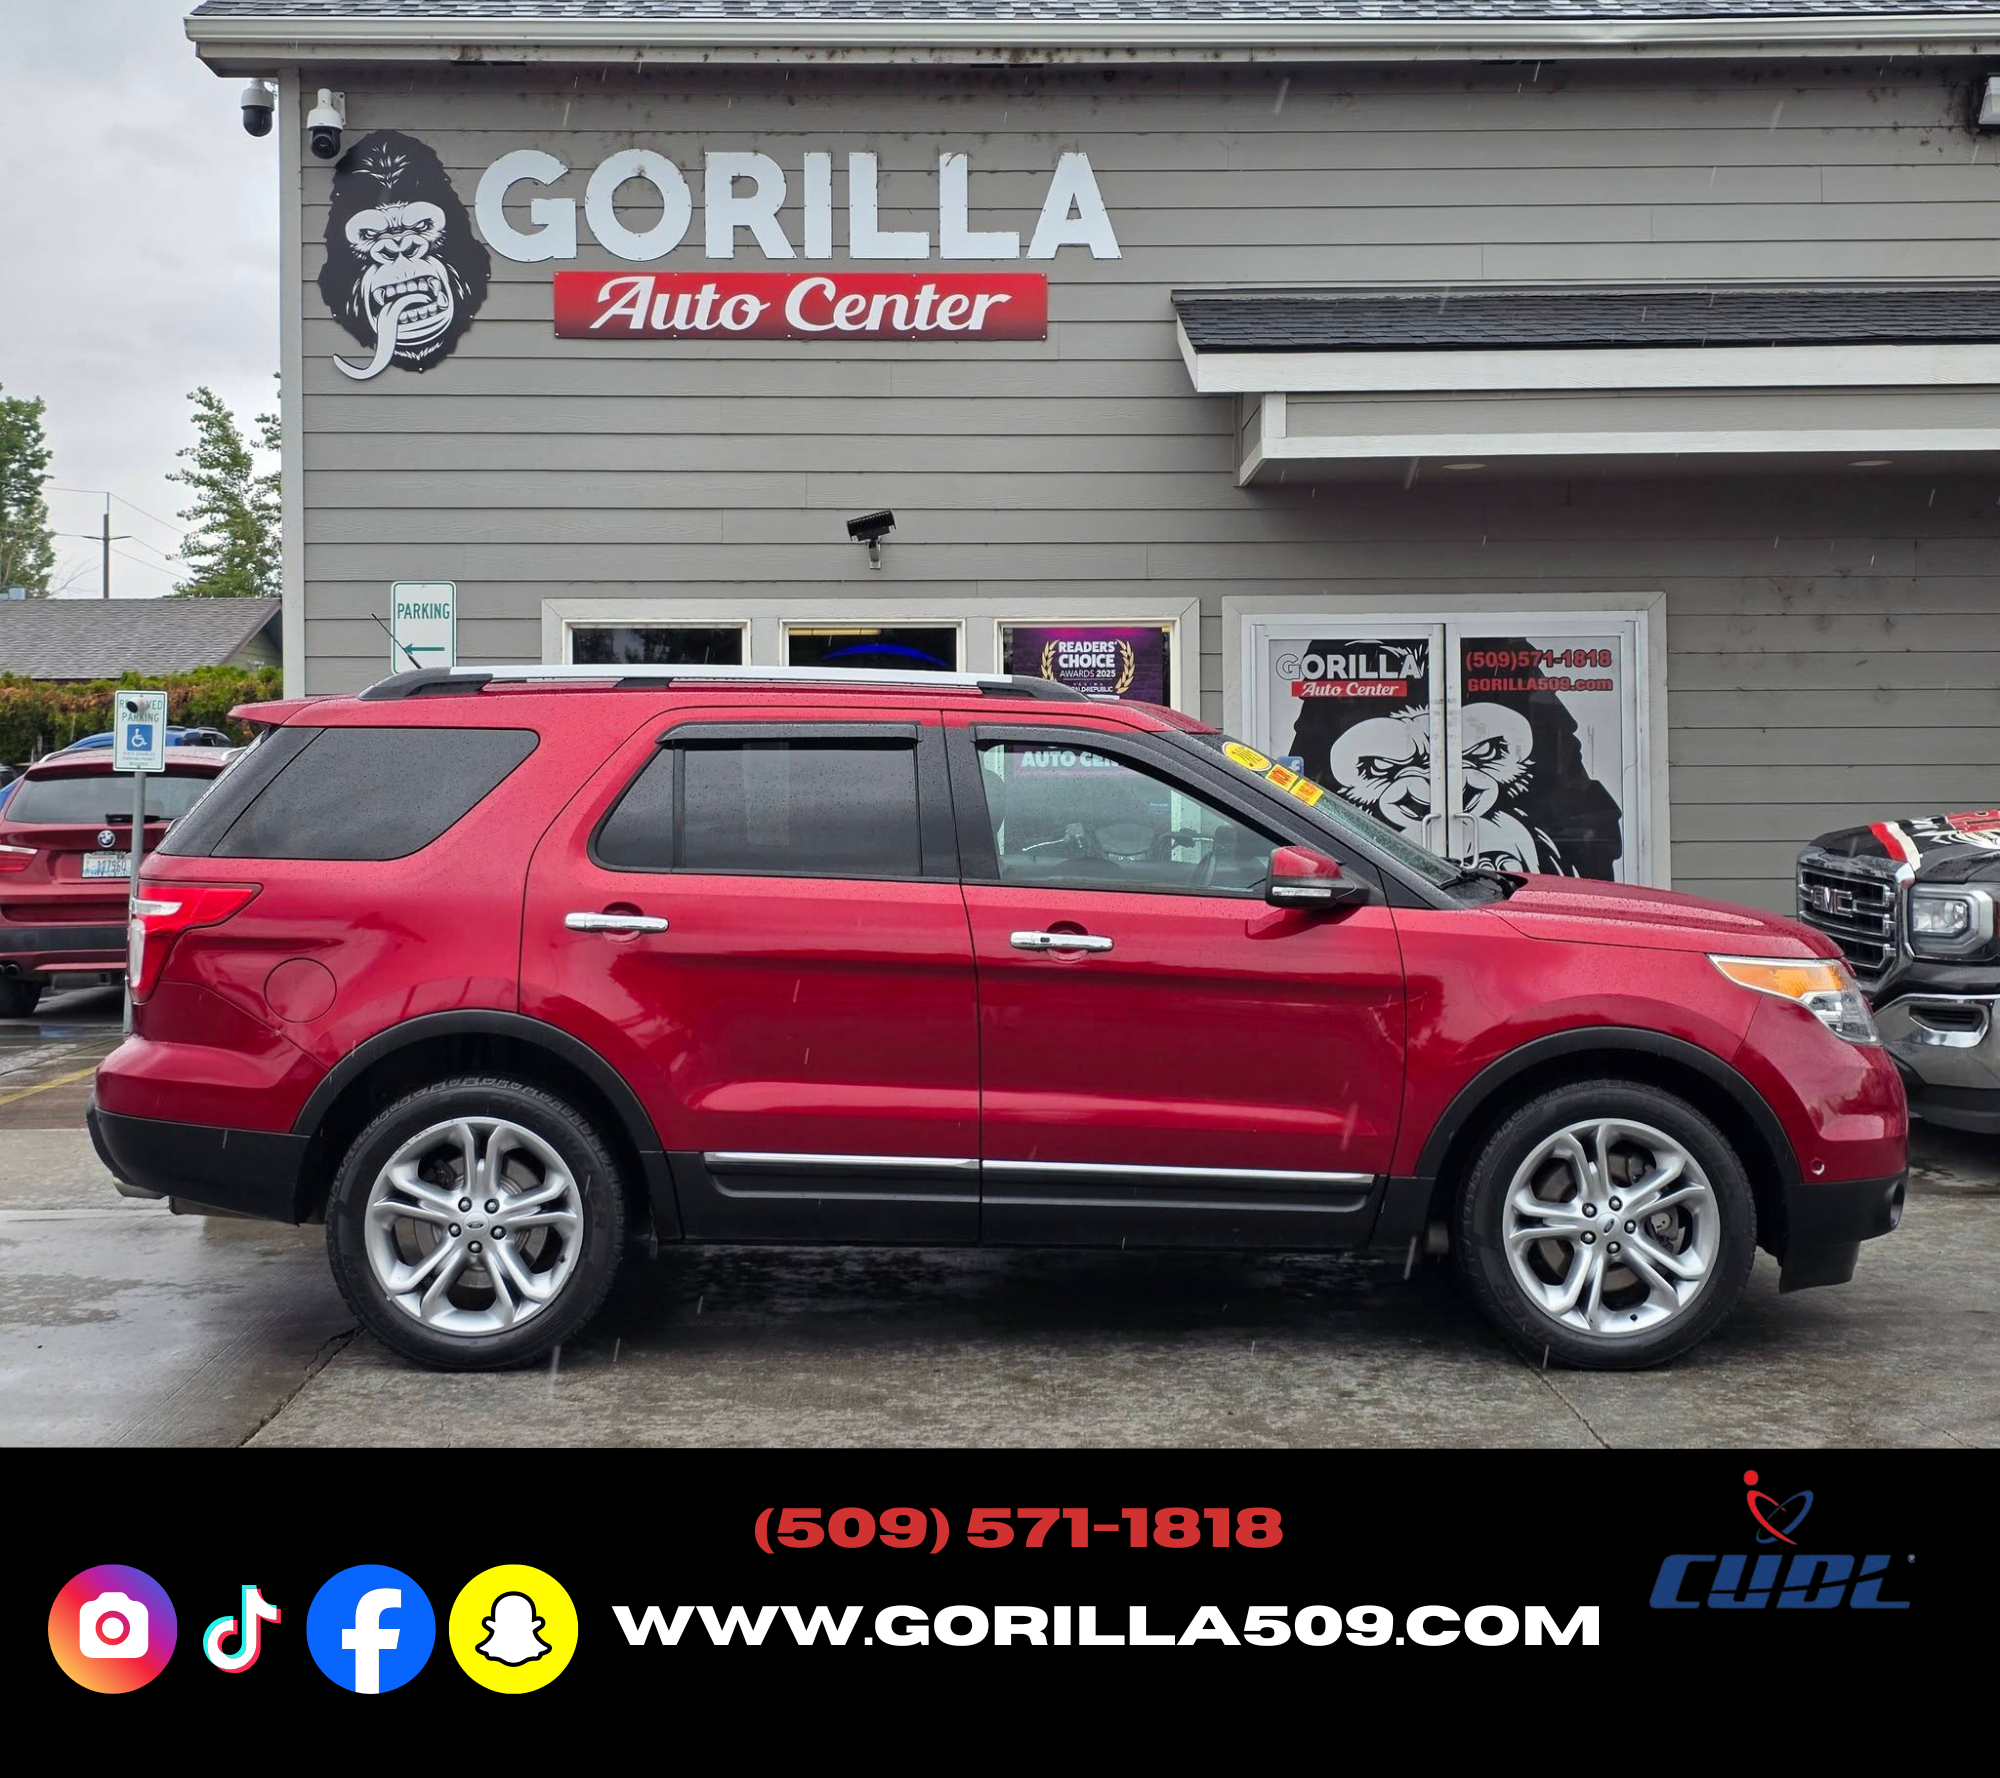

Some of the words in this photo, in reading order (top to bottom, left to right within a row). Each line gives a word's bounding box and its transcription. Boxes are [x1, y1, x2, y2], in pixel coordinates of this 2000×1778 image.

[475, 149, 1122, 262] GORILLA
[590, 276, 770, 331] Auto
[785, 277, 1012, 332] Center
[397, 602, 451, 620] PARKING
[1058, 640, 1118, 653] READERS'
[1058, 654, 1116, 668] CHOICE
[1276, 653, 1422, 680] GORILLA
[1466, 649, 1612, 671] (509)571-1818
[1060, 669, 1095, 678] AWARDS
[1096, 669, 1117, 678] 2025
[1301, 682, 1343, 697] Auto
[1345, 682, 1399, 697] Center
[1468, 677, 1613, 692] GORILLA509.com
[121, 712, 160, 722] PARKING
[1021, 751, 1076, 767] AUTO
[1812, 885, 1853, 918] GMC
